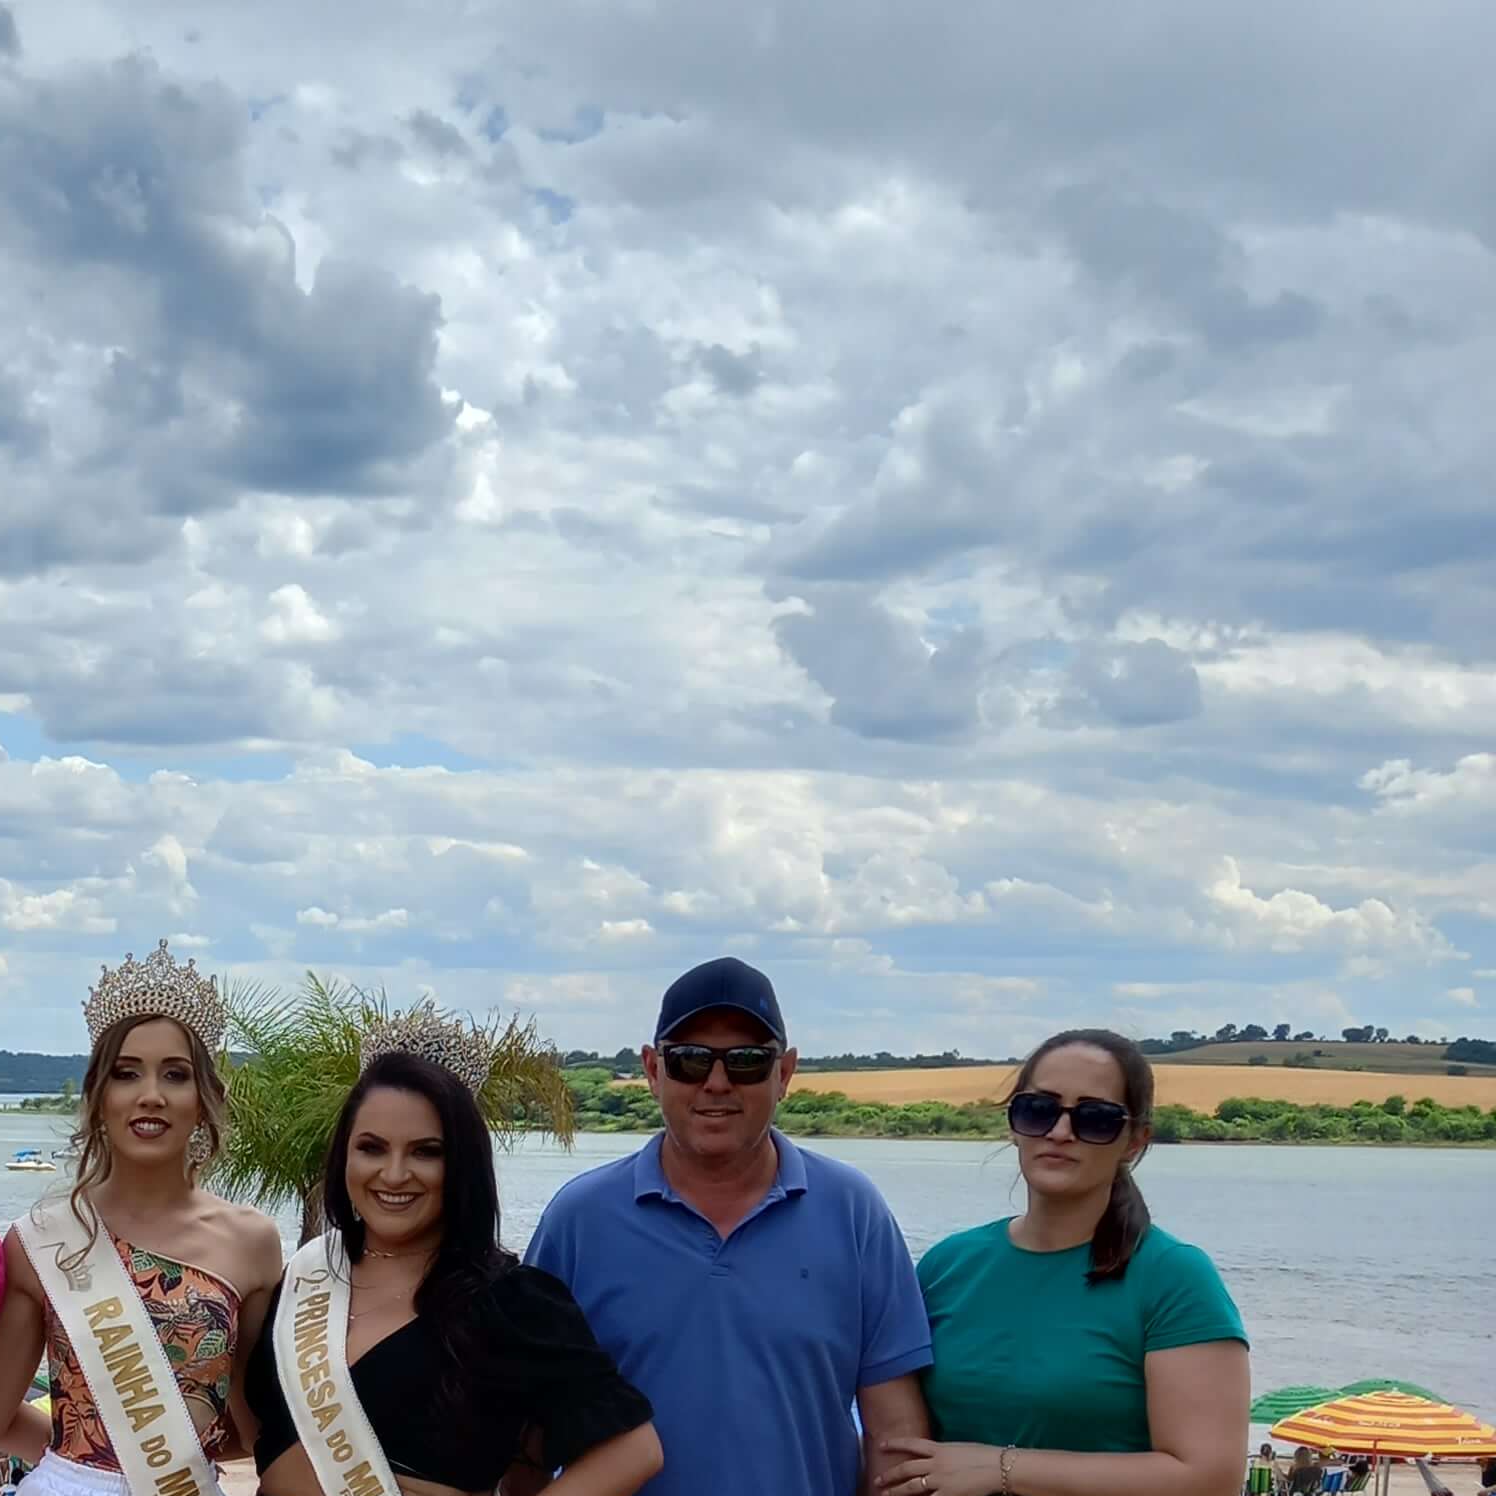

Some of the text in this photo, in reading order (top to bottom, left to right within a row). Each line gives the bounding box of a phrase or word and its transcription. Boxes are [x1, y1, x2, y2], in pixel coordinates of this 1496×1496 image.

[83, 1296, 166, 1432] RAINHA
[140, 1434, 173, 1468] DO
[294, 1291, 343, 1432] PRINCESA
[326, 1429, 353, 1463] DO
